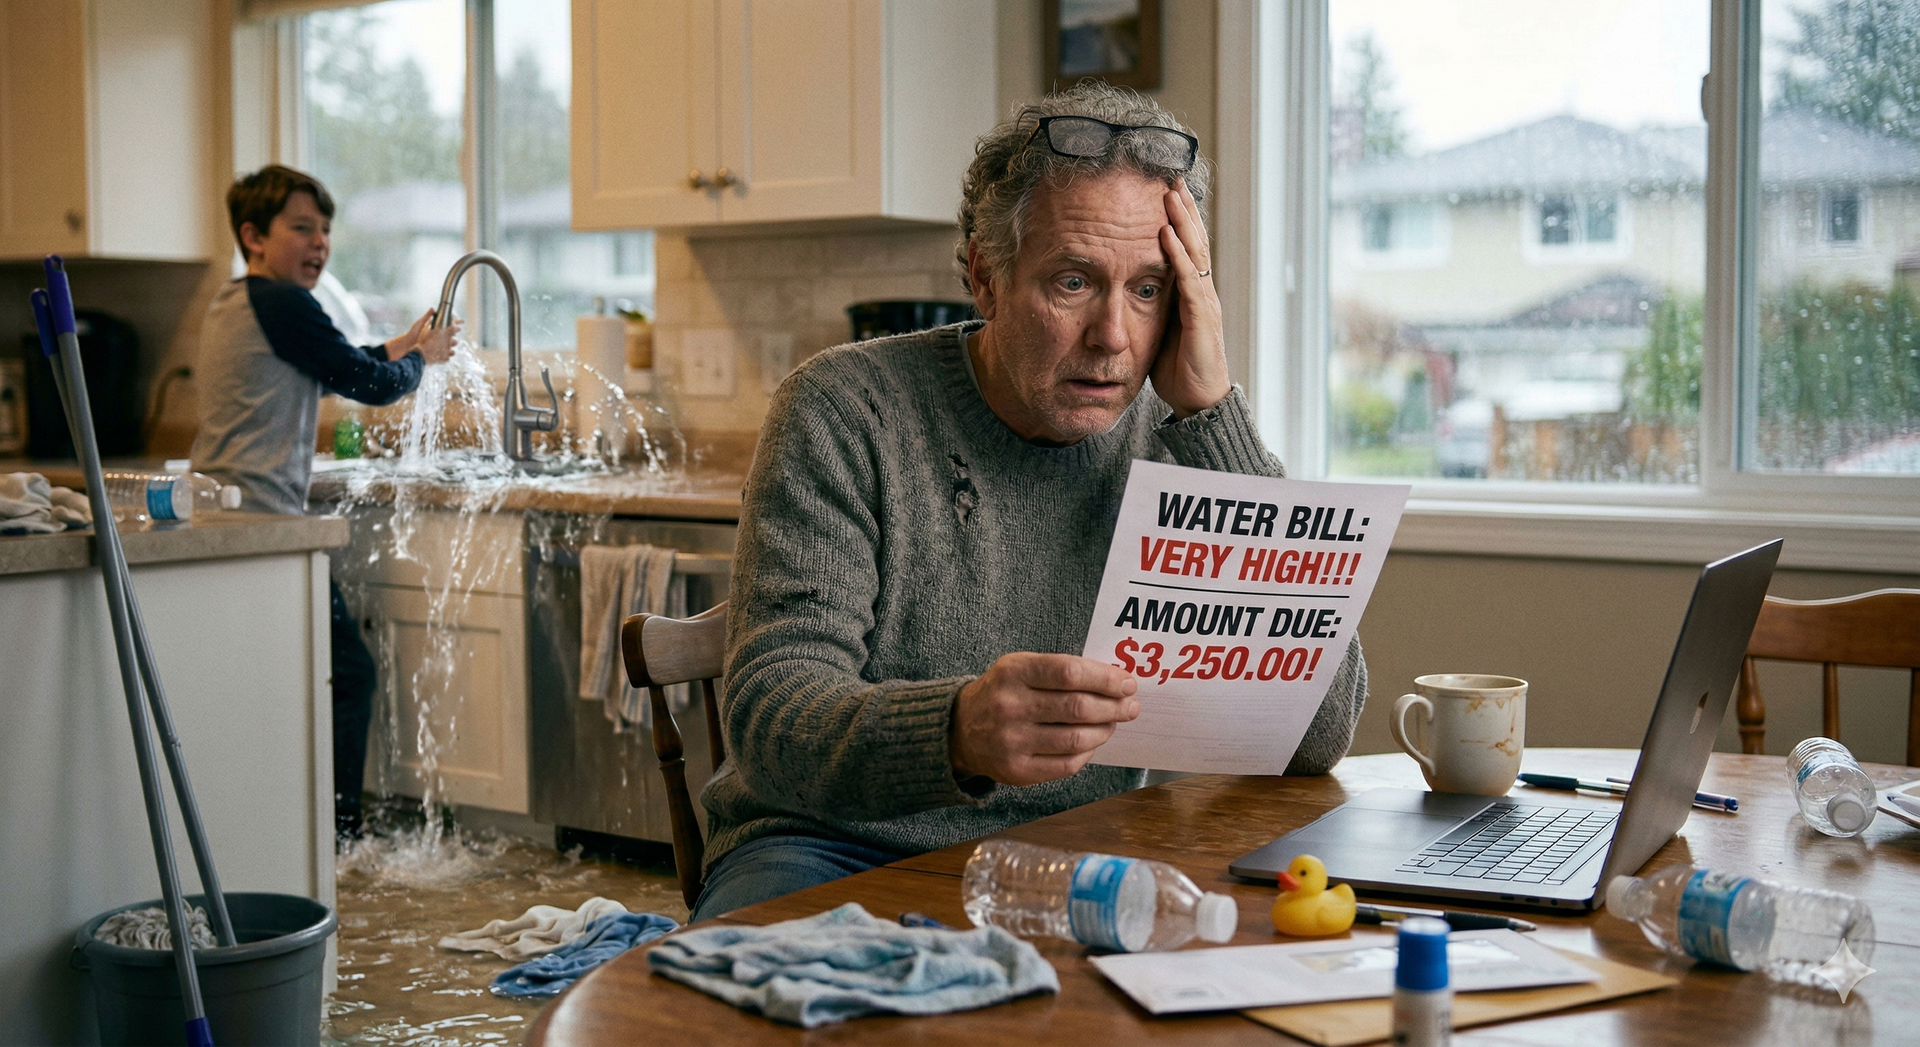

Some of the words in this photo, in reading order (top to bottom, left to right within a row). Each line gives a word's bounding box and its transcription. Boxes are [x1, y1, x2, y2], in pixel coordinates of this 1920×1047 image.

[1157, 491, 1279, 538] WATER
[1285, 505, 1370, 542] BILL:
[1139, 536, 1234, 578] VERY
[1238, 547, 1362, 586] HIGH!!!
[1115, 596, 1264, 637] AMOUNT
[1268, 607, 1342, 638] DUE:
[1111, 636, 1323, 685] $3,250.00!
